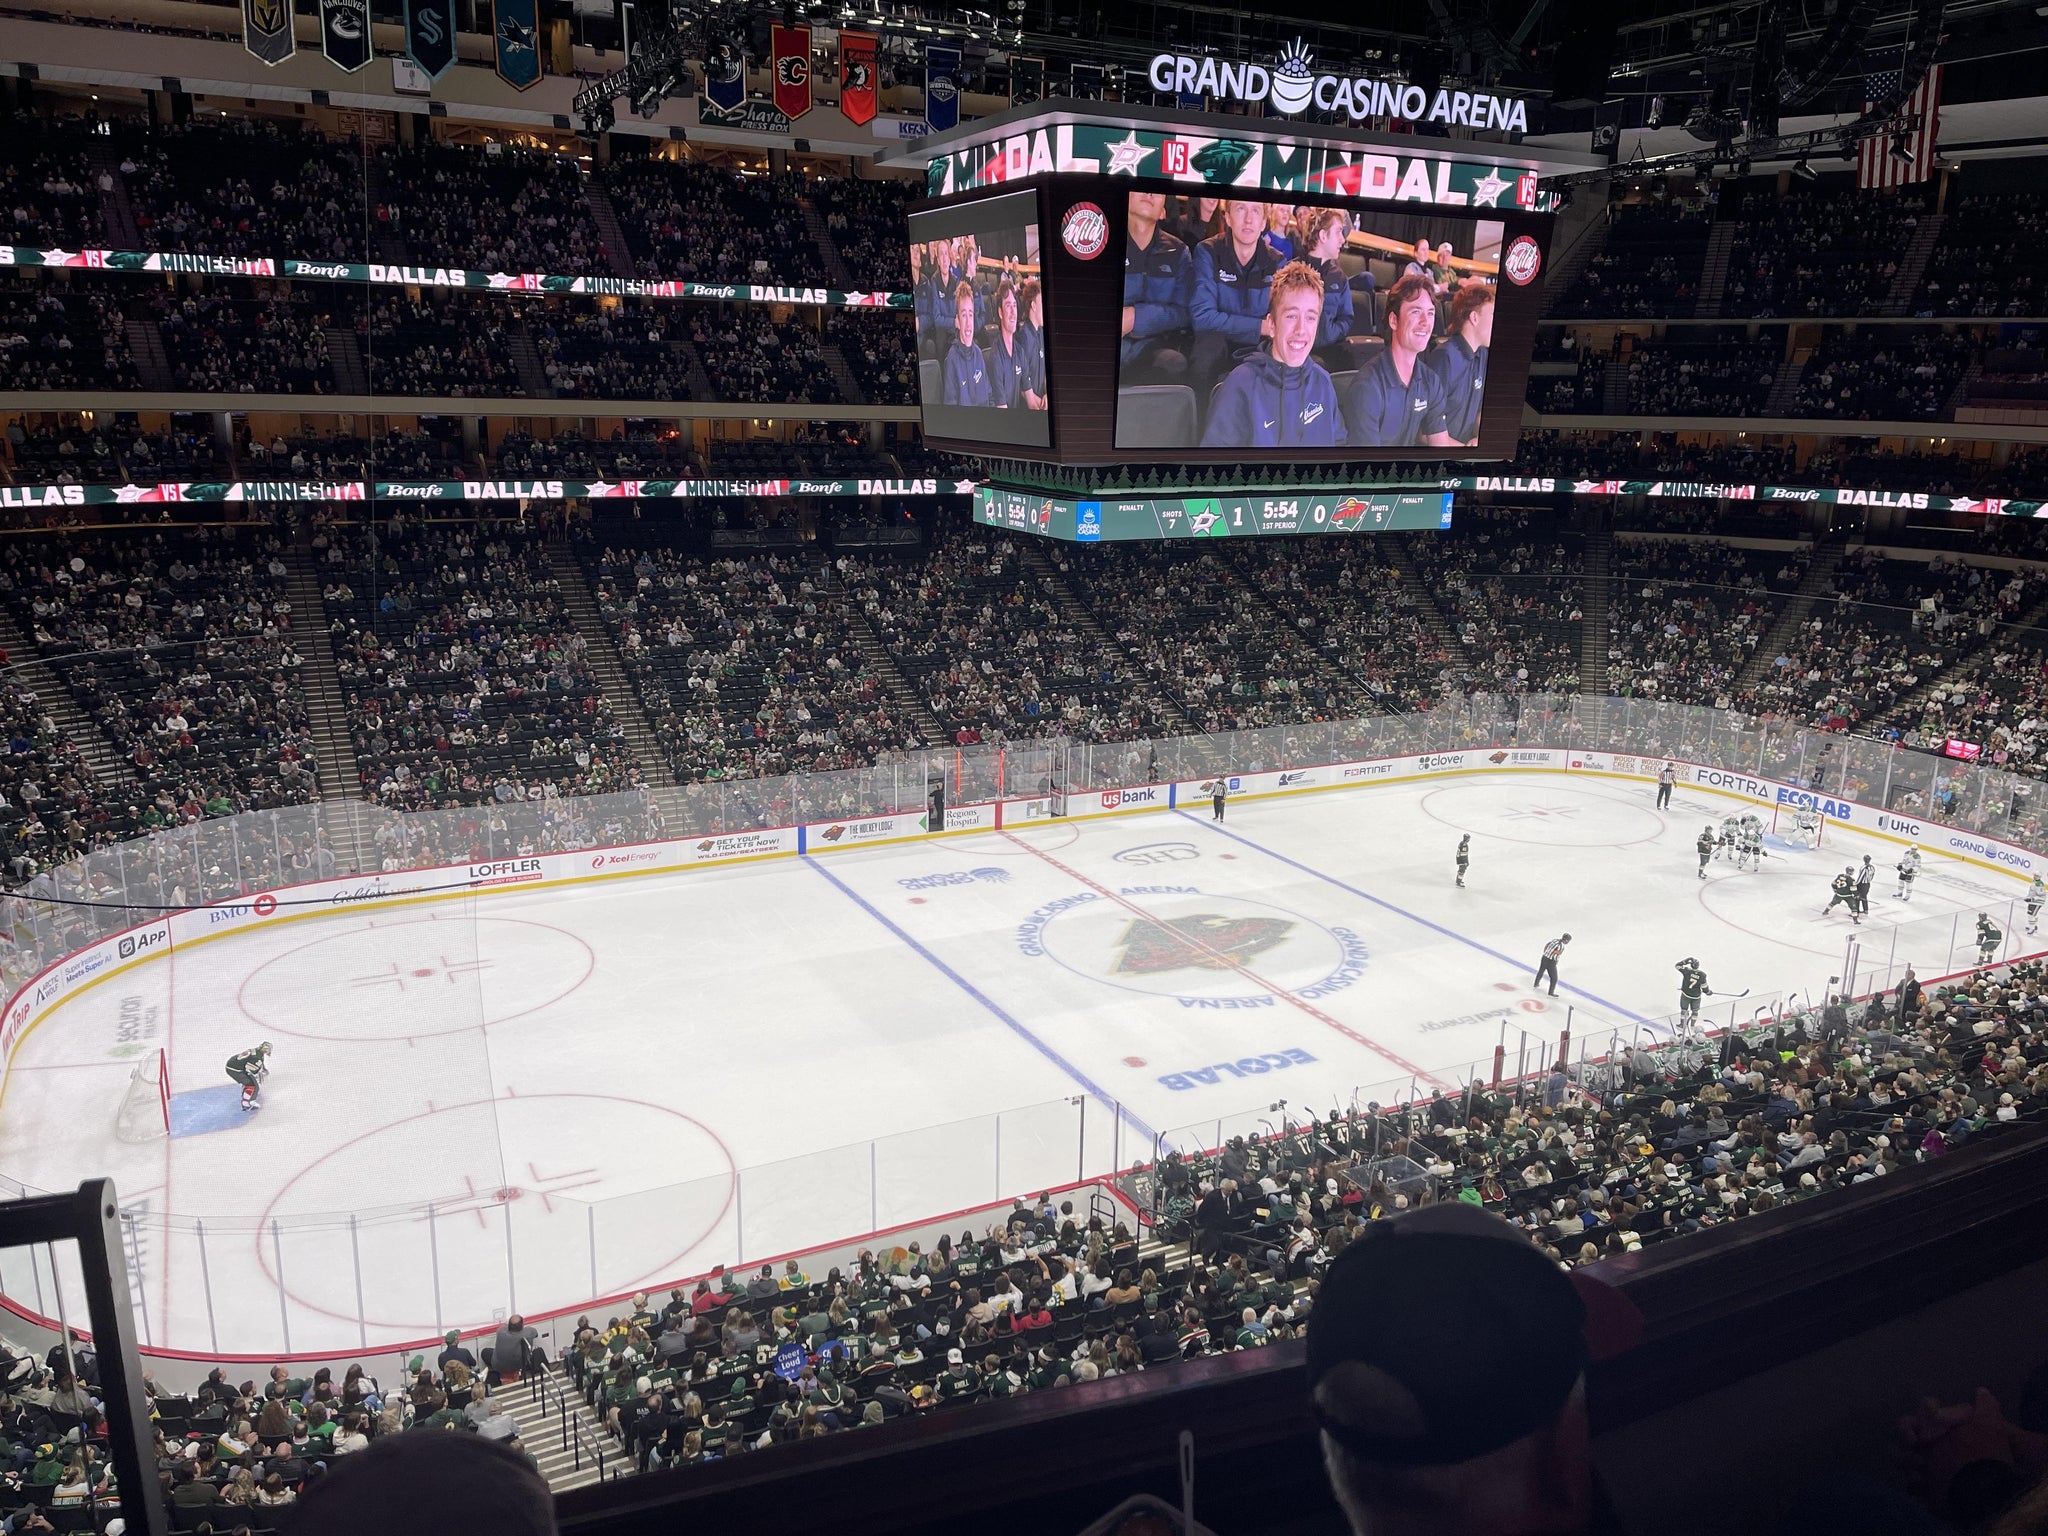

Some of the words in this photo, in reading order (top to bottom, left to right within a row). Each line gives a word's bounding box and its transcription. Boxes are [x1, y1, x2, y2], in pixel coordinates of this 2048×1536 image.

[1149, 54, 1270, 101] GRAND
[1314, 76, 1427, 120] CASINO
[1428, 89, 1528, 133] ARENA
[740, 121, 767, 130] PRESS
[769, 124, 788, 132] BOX
[899, 122, 928, 135] KFAN
[1167, 143, 1184, 171] VS
[1521, 177, 1534, 204] VS
[85, 250, 100, 267] VS
[160, 253, 275, 276] MINNESOTA
[295, 262, 350, 278] Bonfe
[368, 264, 466, 286] DALLAS
[523, 273, 537, 289] VS
[584, 276, 676, 297] MINNESOTA
[693, 284, 736, 298] Bonfe
[750, 285, 828, 304] DALLAS
[873, 291, 884, 306] VS
[162, 483, 178, 500] VS
[243, 482, 366, 501] MINNESOTA
[387, 484, 443, 498] Bonfe
[463, 481, 564, 499] DALLAS
[623, 481, 636, 497] VS
[686, 480, 781, 496] MINNESOTA
[800, 482, 843, 494] Bonfe
[858, 479, 937, 495] DALLAS
[1476, 477, 1555, 492] DALLAS
[1606, 480, 1617, 493] VS
[1663, 481, 1755, 500] MINNESOTA
[1772, 488, 1820, 501] Bonfe
[1837, 489, 1929, 509] DALLAS
[1986, 498, 1999, 514] VS
[998, 503, 1002, 518] 1
[1008, 503, 1026, 520] 5:54
[1031, 508, 1037, 524] 0
[1162, 510, 1182, 518] SHOTS
[1233, 506, 1243, 526] 1
[1263, 501, 1298, 519] 5:54
[1314, 504, 1326, 523] 0
[1375, 513, 1382, 522] 5
[1169, 519, 1175, 529] 7
[1262, 522, 1274, 530] 1ST
[1275, 521, 1297, 529] PERIOD
[1431, 754, 1464, 767] clover
[1511, 752, 1519, 760] THE
[1520, 752, 1535, 761] HOCKEY
[1536, 752, 1550, 761] LODGE
[1641, 758, 1664, 767] WOODY
[1344, 764, 1392, 777] FORTINET
[1583, 761, 1604, 770] YouTube
[1674, 762, 1691, 771] OODY
[1674, 768, 1690, 776] REEK
[1697, 769, 1768, 798] FORTRA
[1776, 787, 1852, 820] ECOLAB
[946, 808, 977, 820] Regions
[946, 815, 980, 828] Hospital
[849, 824, 859, 834] THE
[859, 822, 878, 833] HOCKEY
[878, 820, 893, 831] LODGE
[1891, 819, 1920, 836] UHC
[717, 842, 754, 851] TICKETS
[757, 838, 779, 847] NOW!
[609, 854, 629, 864] Xcel
[630, 851, 658, 862] Energy
[1949, 837, 1985, 854] GRAND
[1997, 851, 2031, 869] CASINO
[470, 859, 542, 878] LOFFLER
[1121, 885, 1200, 895] ARENA
[209, 906, 248, 924] BMO
[1016, 923, 1044, 957] GRAND
[1034, 892, 1097, 920] CASINO
[137, 930, 166, 950] APP
[1331, 926, 1370, 961] GRAND
[64, 961, 81, 975] Super
[66, 968, 85, 984] Meets
[85, 960, 104, 973] Super
[42, 975, 59, 991] ARCTIC
[1300, 967, 1363, 1000] CASINO
[45, 985, 59, 999] WOLF
[1177, 996, 1275, 1009] ARENA
[11, 1003, 30, 1034] TRIP
[1157, 1047, 1320, 1091] ECOLAB
[778, 1349, 800, 1362] Cheer
[781, 1357, 801, 1370] Loud
